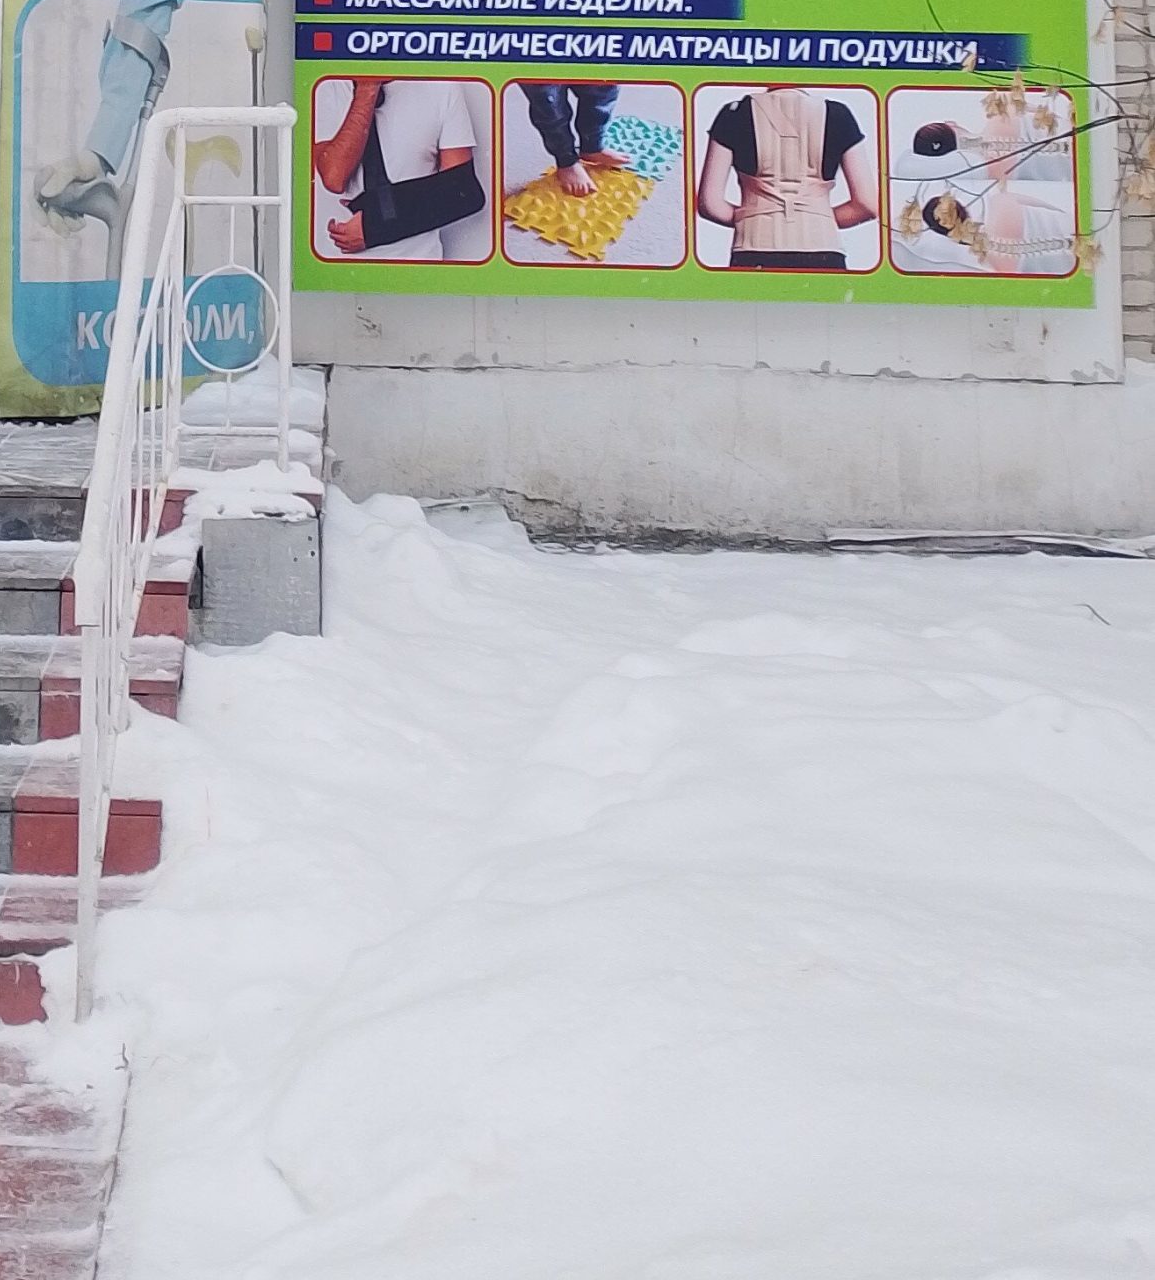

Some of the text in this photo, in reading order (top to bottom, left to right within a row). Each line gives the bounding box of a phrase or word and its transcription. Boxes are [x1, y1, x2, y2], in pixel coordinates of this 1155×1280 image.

[347, 31, 986, 67] ОРТОПЕДИЧЕСКИЕ МАТРАЦЫ И ПОДУШКИ.
